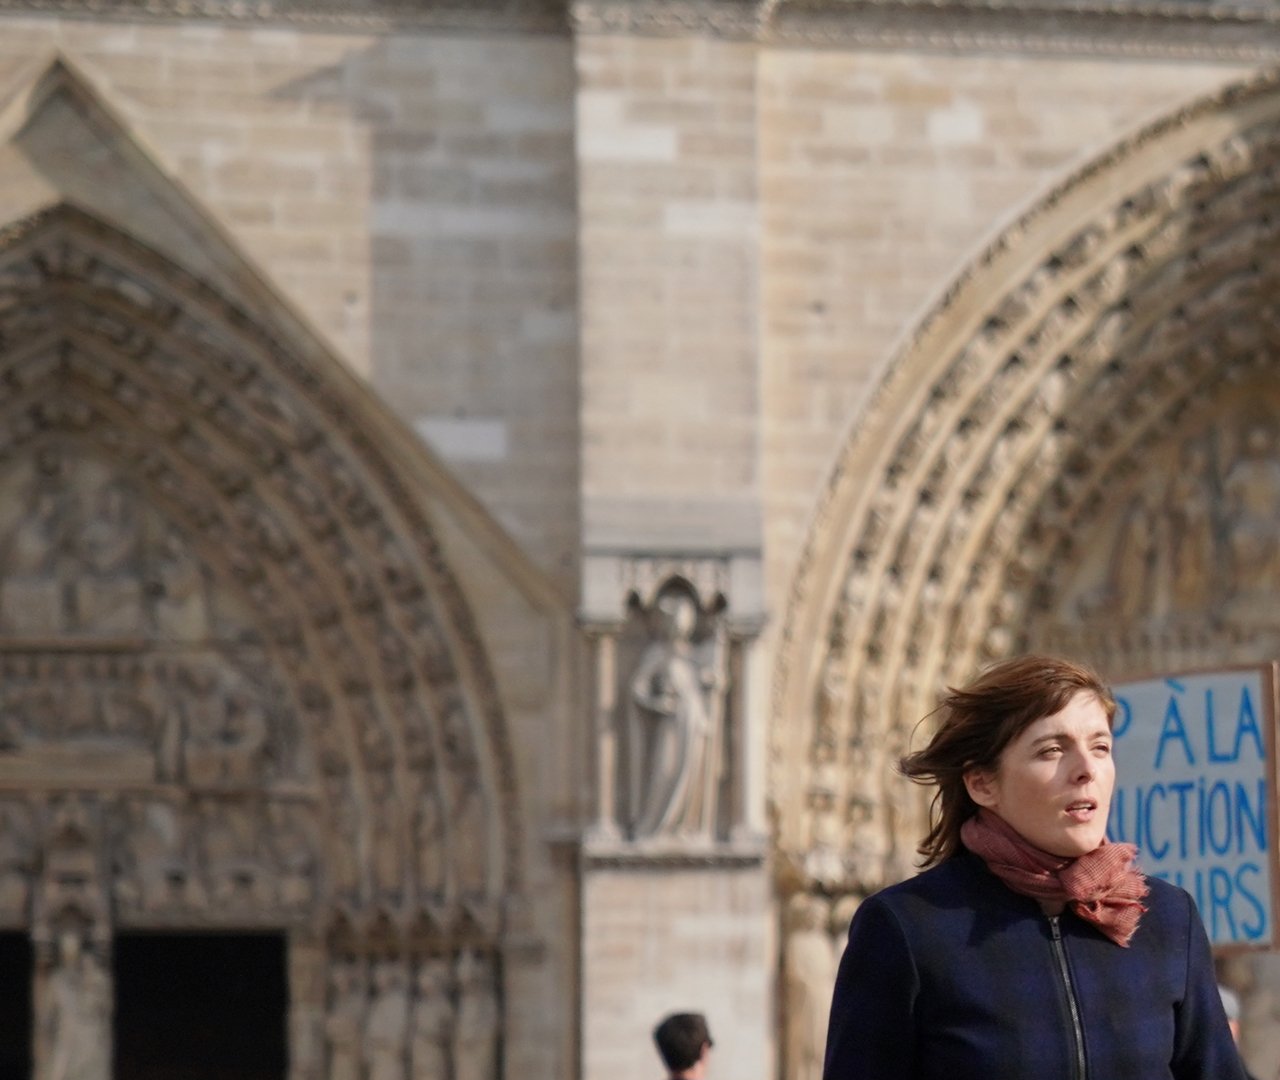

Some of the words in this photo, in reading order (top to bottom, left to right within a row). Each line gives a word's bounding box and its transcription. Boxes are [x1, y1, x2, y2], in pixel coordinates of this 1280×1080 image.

[1155, 678, 1195, 769] À
[1206, 684, 1265, 763] LA
[1106, 776, 1267, 861] UCTION
